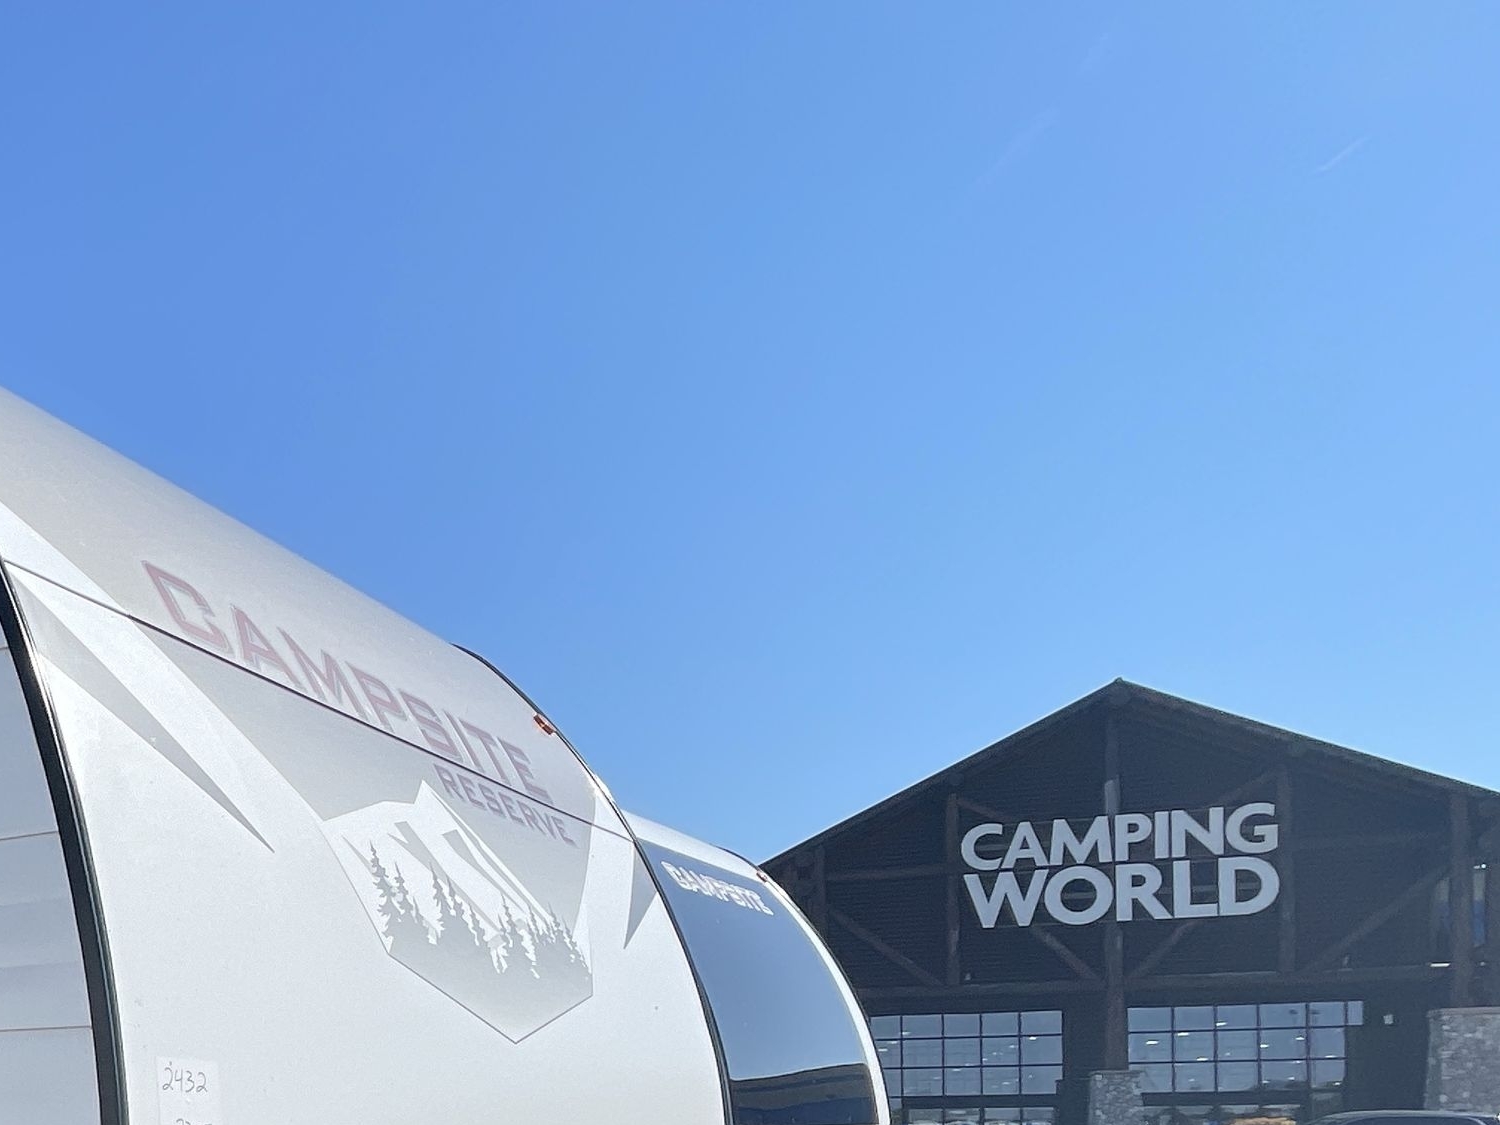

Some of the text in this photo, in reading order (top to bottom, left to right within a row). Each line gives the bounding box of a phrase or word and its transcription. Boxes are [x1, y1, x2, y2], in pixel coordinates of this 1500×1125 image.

[142, 559, 552, 801] CAMPSITE
[433, 763, 577, 848] RESERVE
[961, 801, 1279, 871] CAMPING
[963, 855, 1280, 929] WORLD
[162, 1066, 208, 1093] 2432
